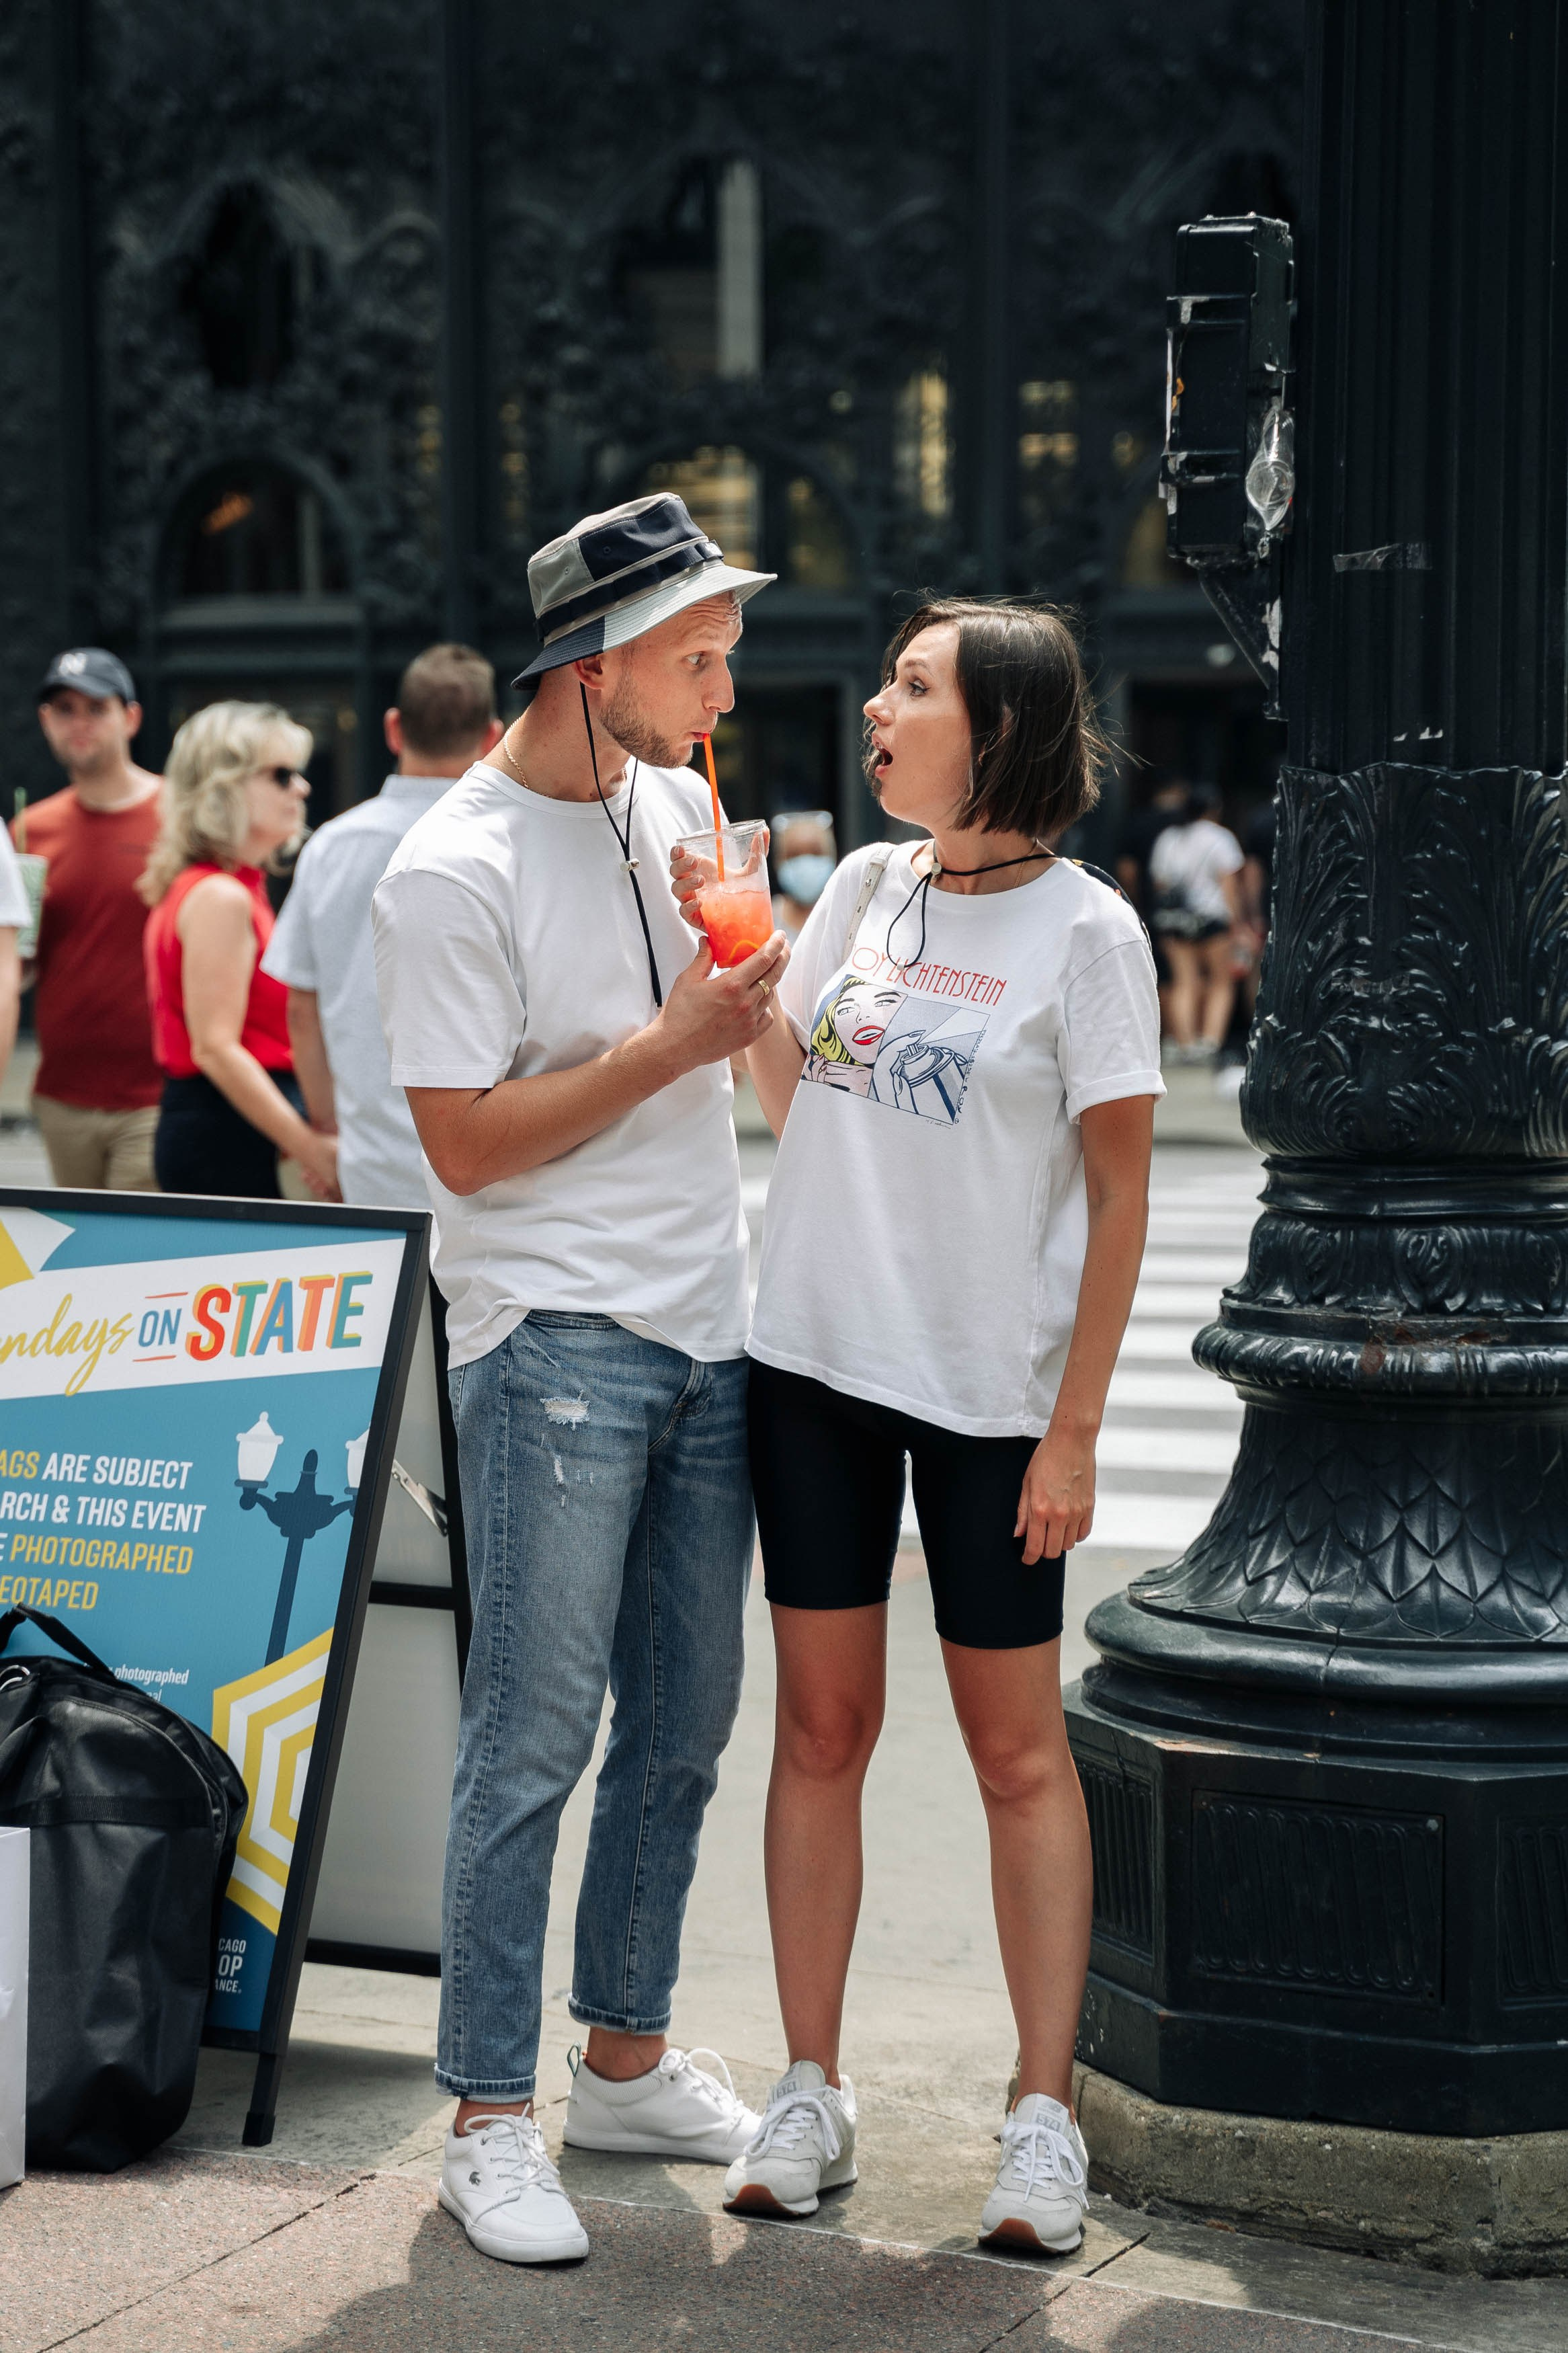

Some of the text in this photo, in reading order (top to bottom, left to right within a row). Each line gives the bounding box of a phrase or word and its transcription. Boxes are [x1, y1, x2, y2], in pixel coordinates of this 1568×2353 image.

[852, 947, 1007, 1006] OY LICHTENSTEIN
[0, 1271, 373, 1396] ndays ON STATE
[41, 1452, 91, 1483] ARE
[93, 1455, 194, 1490] SUBJECT
[50, 1494, 71, 1524] &
[76, 1496, 128, 1528] THIS
[130, 1500, 207, 1533] EVENT
[9, 1533, 194, 1575] PHOTOGRAPHED
[114, 1663, 190, 1686] photographed
[218, 1938, 246, 1953] CAGO
